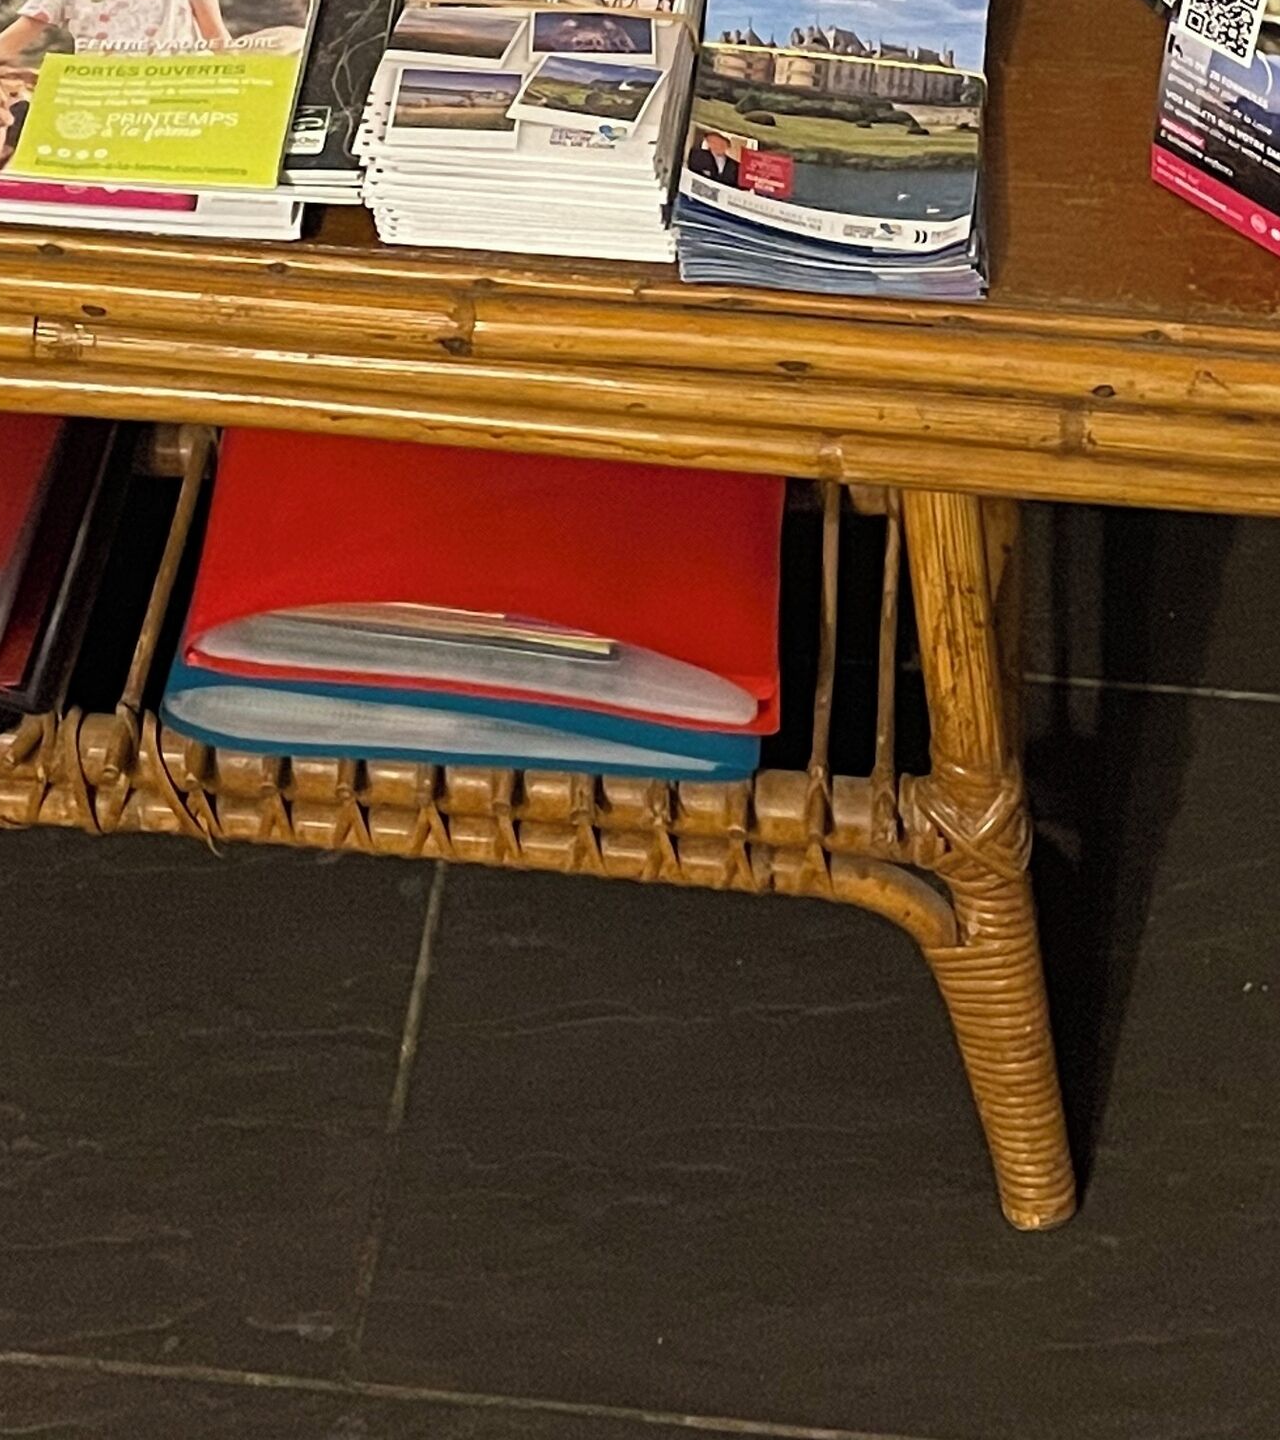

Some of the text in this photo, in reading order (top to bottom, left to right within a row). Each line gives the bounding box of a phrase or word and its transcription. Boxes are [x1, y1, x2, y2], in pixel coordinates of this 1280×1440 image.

[64, 64, 246, 76] PORTES OUVERTES
[105, 111, 239, 128] PRINTEMPS
